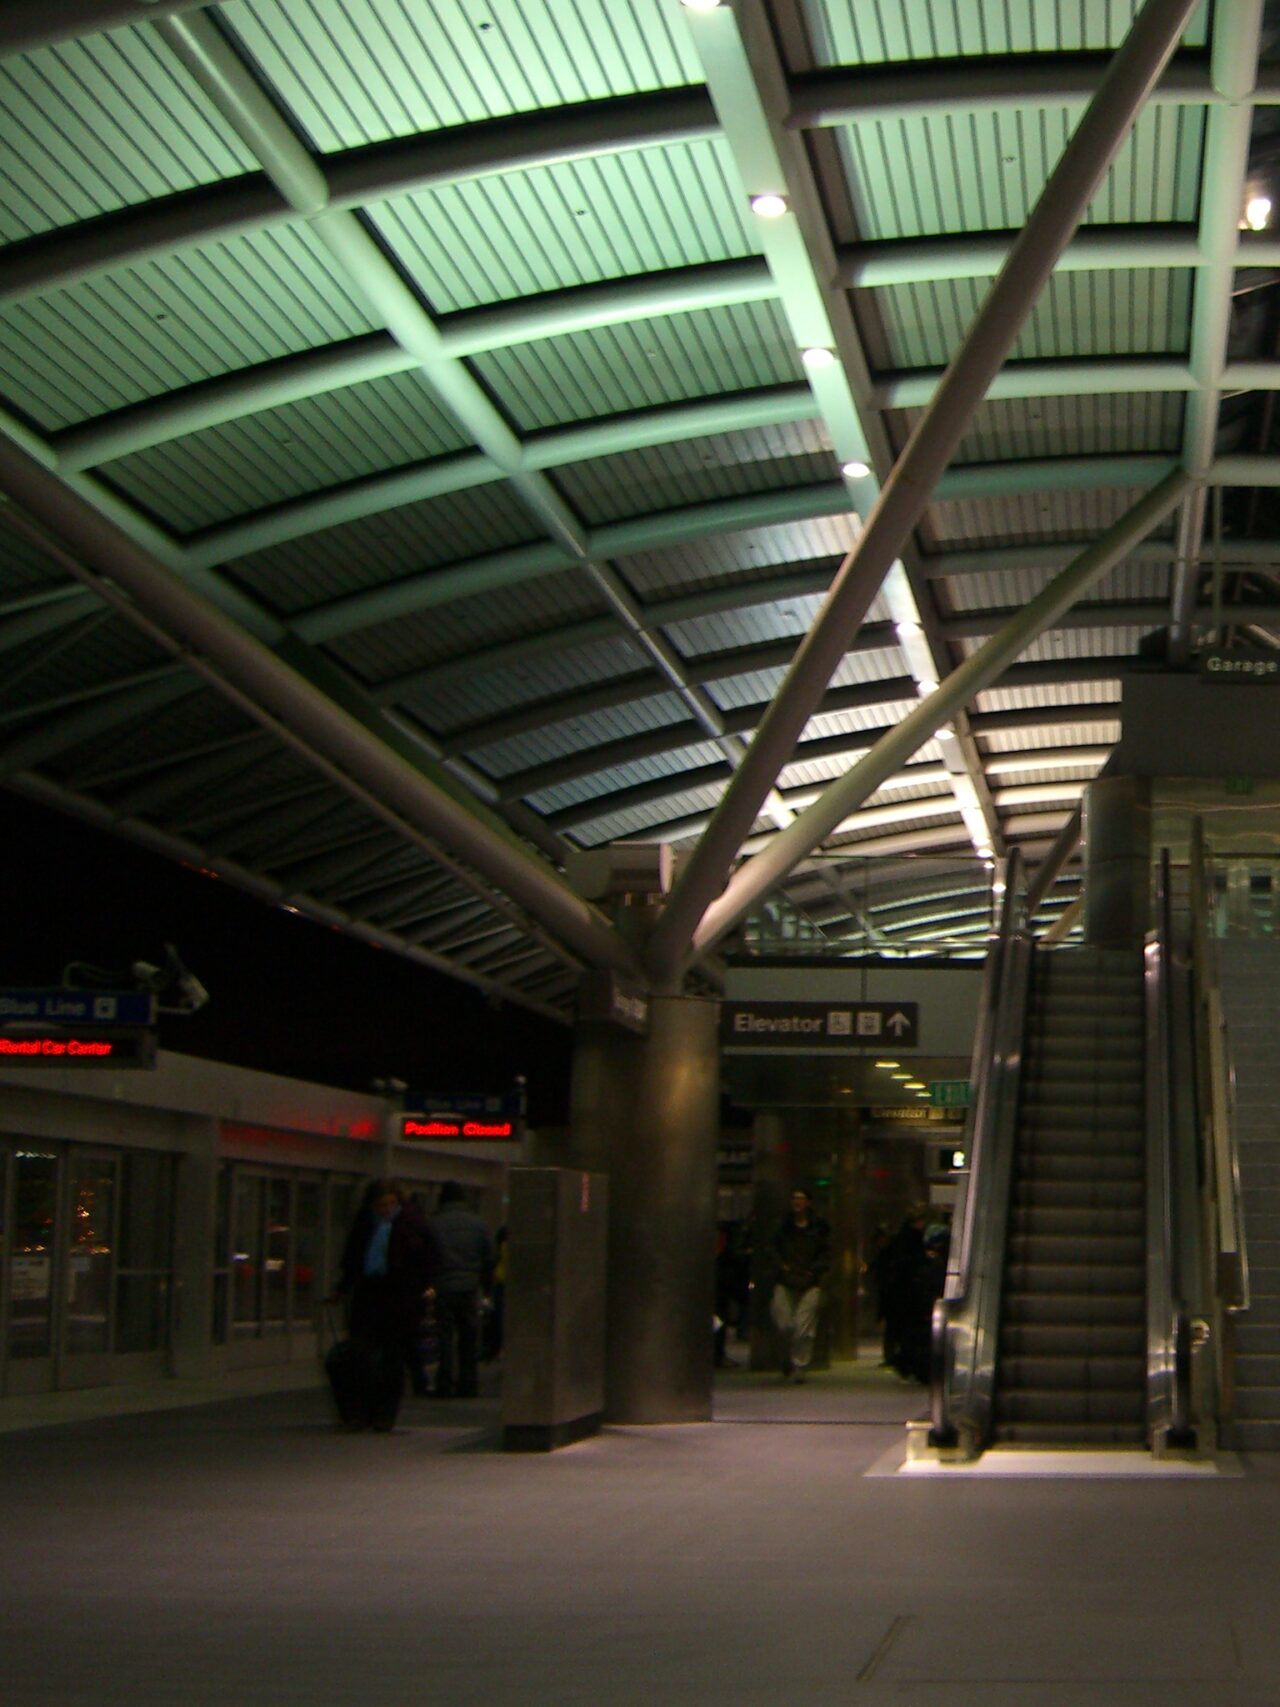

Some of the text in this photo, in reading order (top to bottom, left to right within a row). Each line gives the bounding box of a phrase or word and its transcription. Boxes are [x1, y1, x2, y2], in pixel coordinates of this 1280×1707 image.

[1207, 656, 1278, 676] Garage
[734, 1013, 824, 1032] Elevator
[42, 1037, 66, 1056] Car
[67, 1037, 114, 1056] Center
